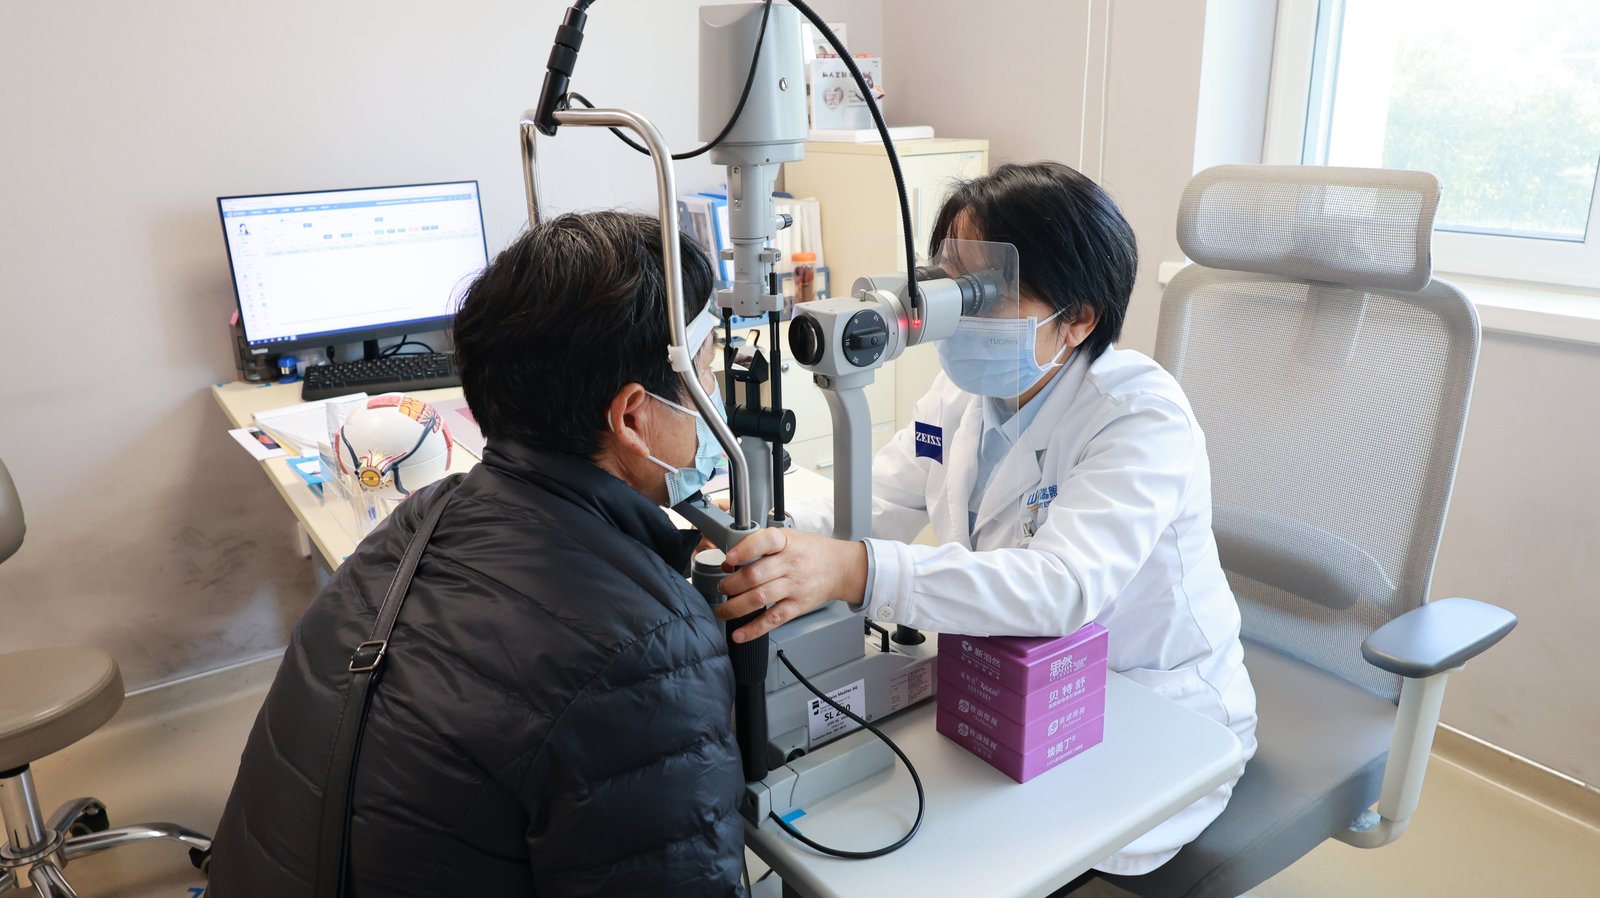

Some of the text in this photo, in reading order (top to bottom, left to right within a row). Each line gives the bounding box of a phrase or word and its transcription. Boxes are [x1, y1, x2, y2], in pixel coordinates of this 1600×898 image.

[916, 431, 942, 447] ZEISS
[1049, 676, 1085, 703] 贝特舒
[824, 711, 834, 721] SL
[836, 704, 851, 717] 20
